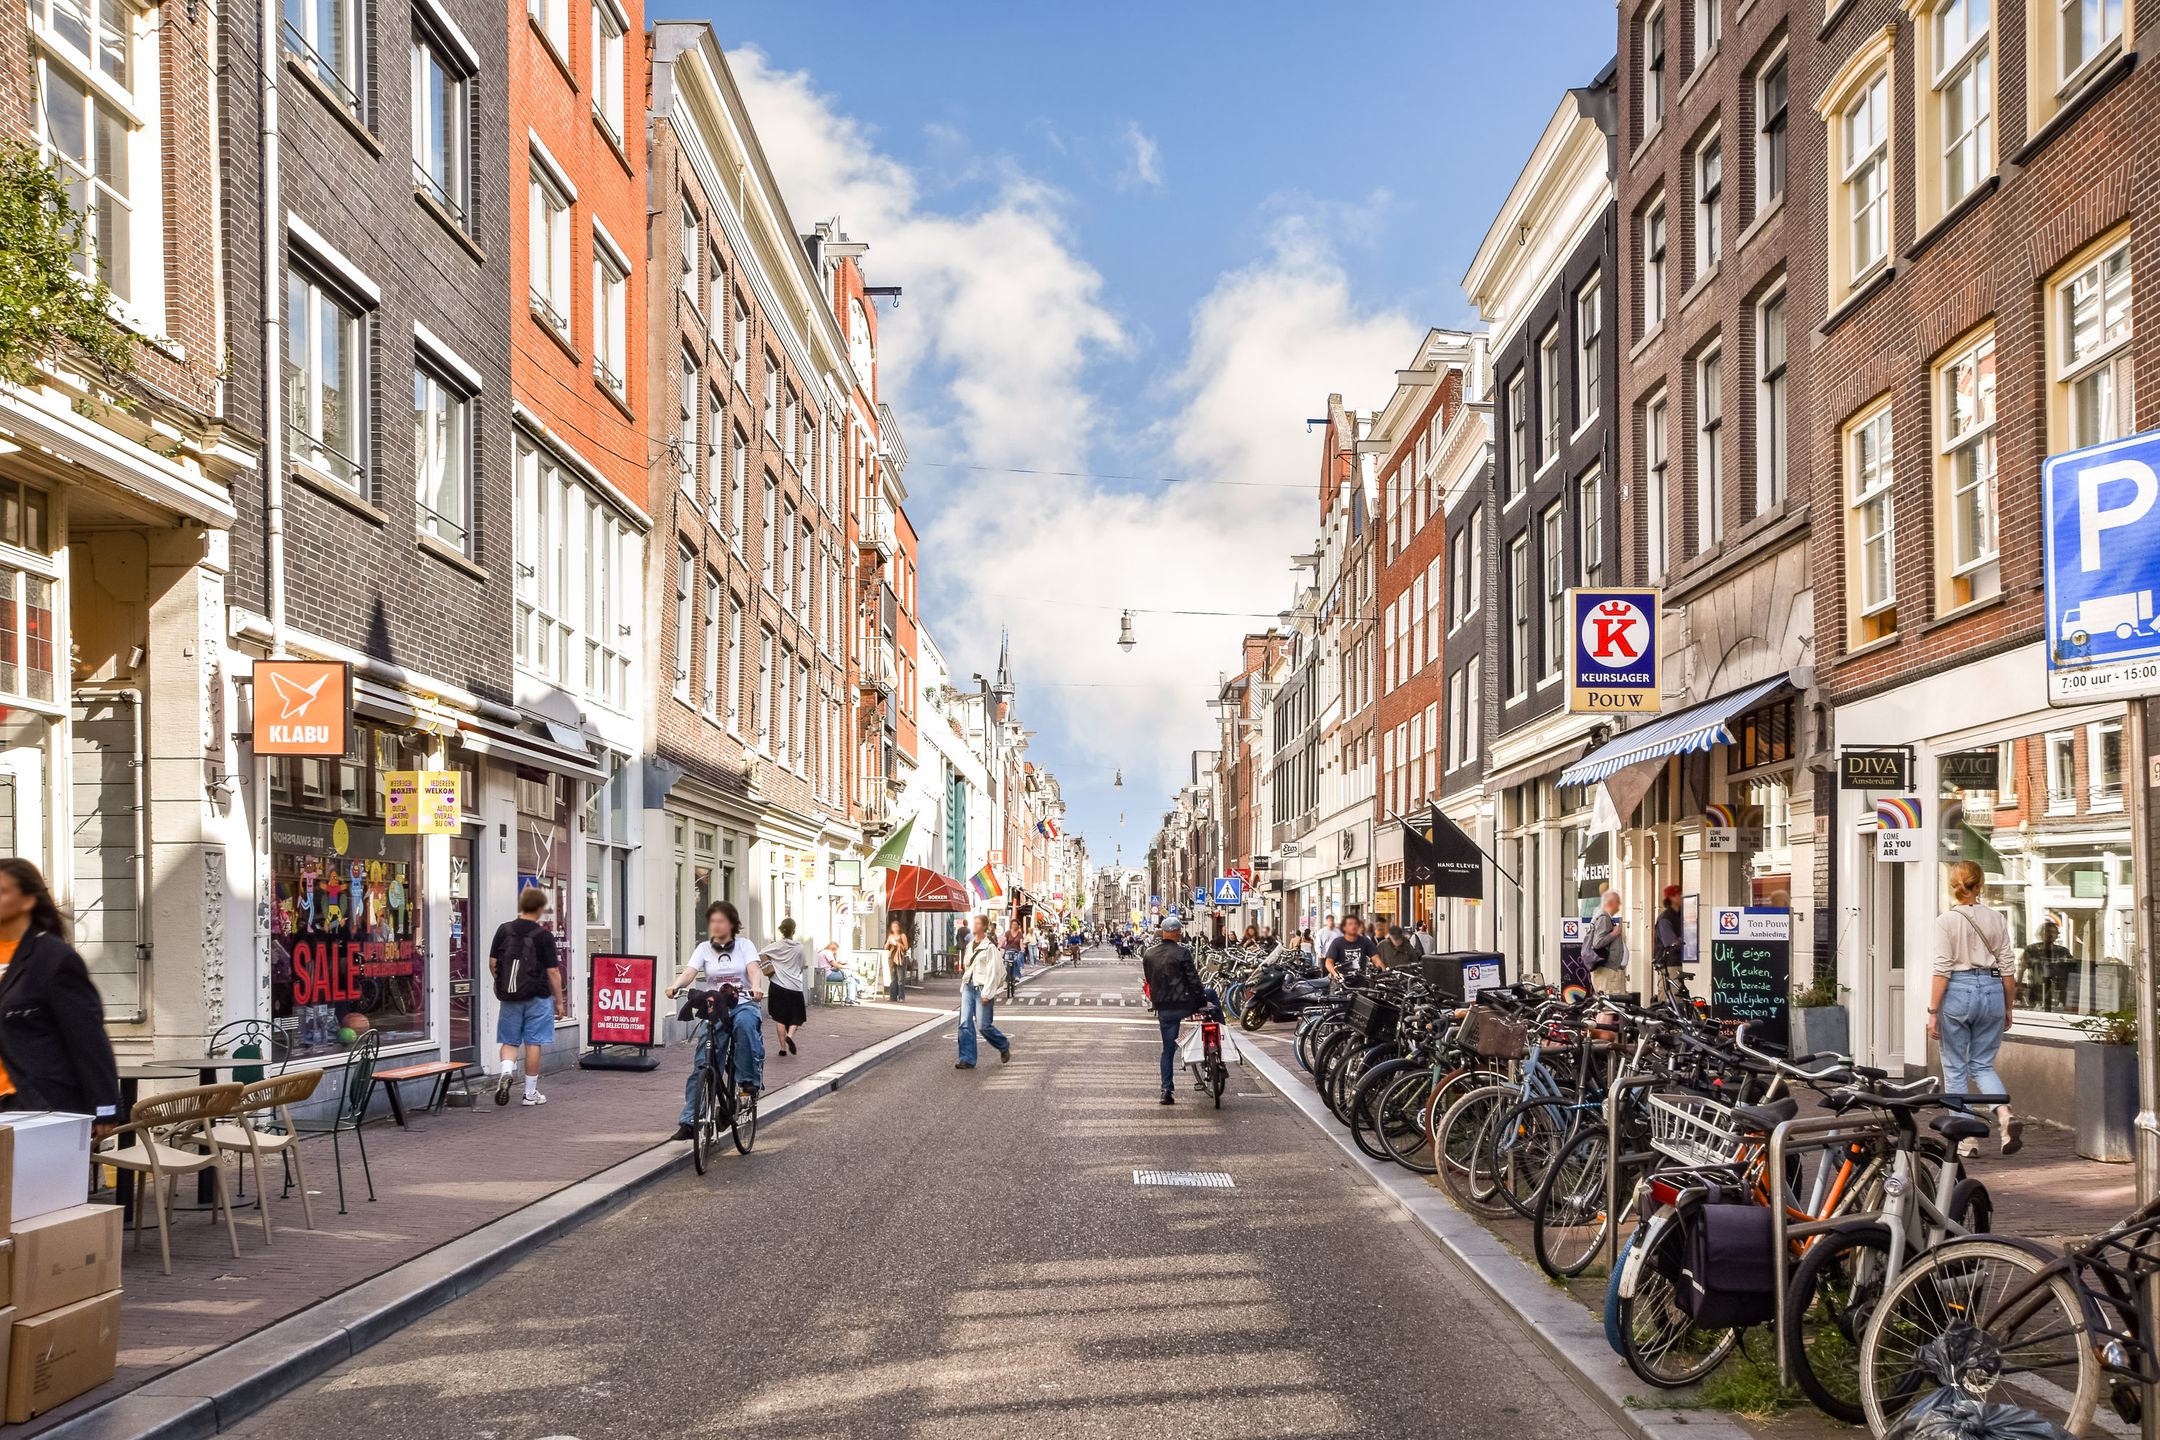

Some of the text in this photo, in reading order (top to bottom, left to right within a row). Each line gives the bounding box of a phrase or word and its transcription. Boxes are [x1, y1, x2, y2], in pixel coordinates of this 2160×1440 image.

[2078, 459, 2158, 573] P
[1592, 619, 1638, 657] K
[1581, 673, 1650, 683] KEURSLAGER
[2061, 674, 2087, 689] 7:00
[2091, 671, 2112, 685] uur
[2124, 665, 2158, 681] 15:00
[269, 725, 329, 743] KLABU
[1848, 757, 1899, 774] DIVA
[1852, 777, 1895, 785] Amsterdam
[1883, 832, 1899, 840] COME
[1282, 844, 1298, 853] Etos
[1747, 920, 1788, 928] Ton Pouw
[1750, 931, 1787, 939] Aanbieding
[1714, 943, 1771, 961] Uit eigen
[293, 942, 362, 1005] SALE
[1713, 976, 1771, 991] Vers bereide
[598, 988, 647, 1012] SALE
[1713, 991, 1786, 1007] Maaltijden en
[1732, 1005, 1768, 1019] Soepen
